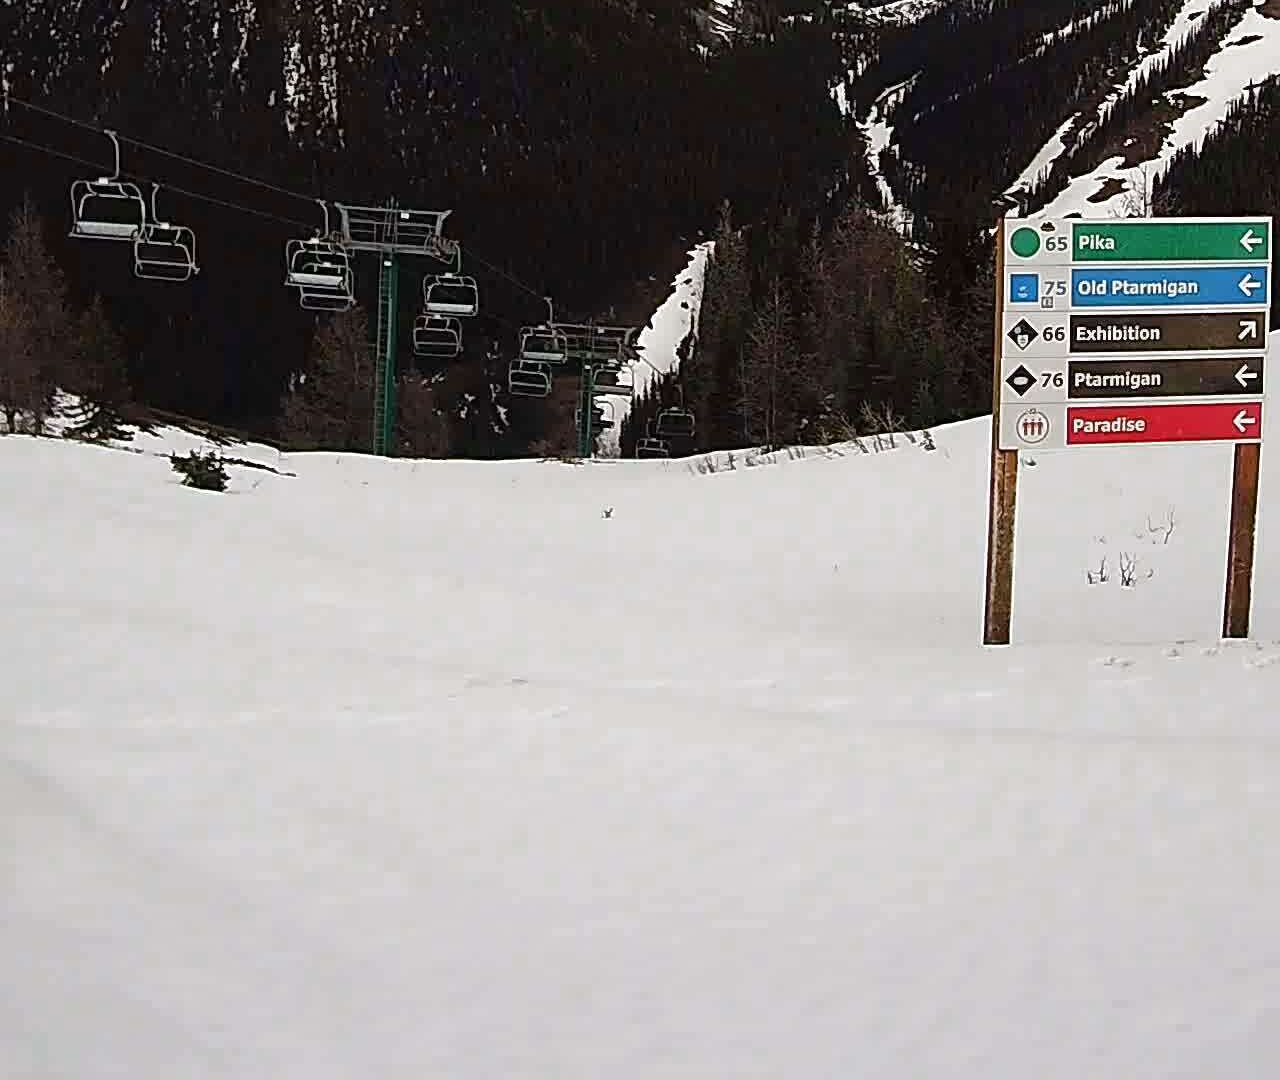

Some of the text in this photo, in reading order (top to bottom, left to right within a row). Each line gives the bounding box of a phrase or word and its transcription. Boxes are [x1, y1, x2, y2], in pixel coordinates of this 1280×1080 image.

[1045, 234, 1115, 251] 65 Pika
[1044, 277, 1198, 299] 75 Old Ptarmigan
[1042, 325, 1161, 342] 66 Exhibition
[1041, 370, 1161, 392] 76 Ptarmigan
[1072, 417, 1146, 434] Paradise
